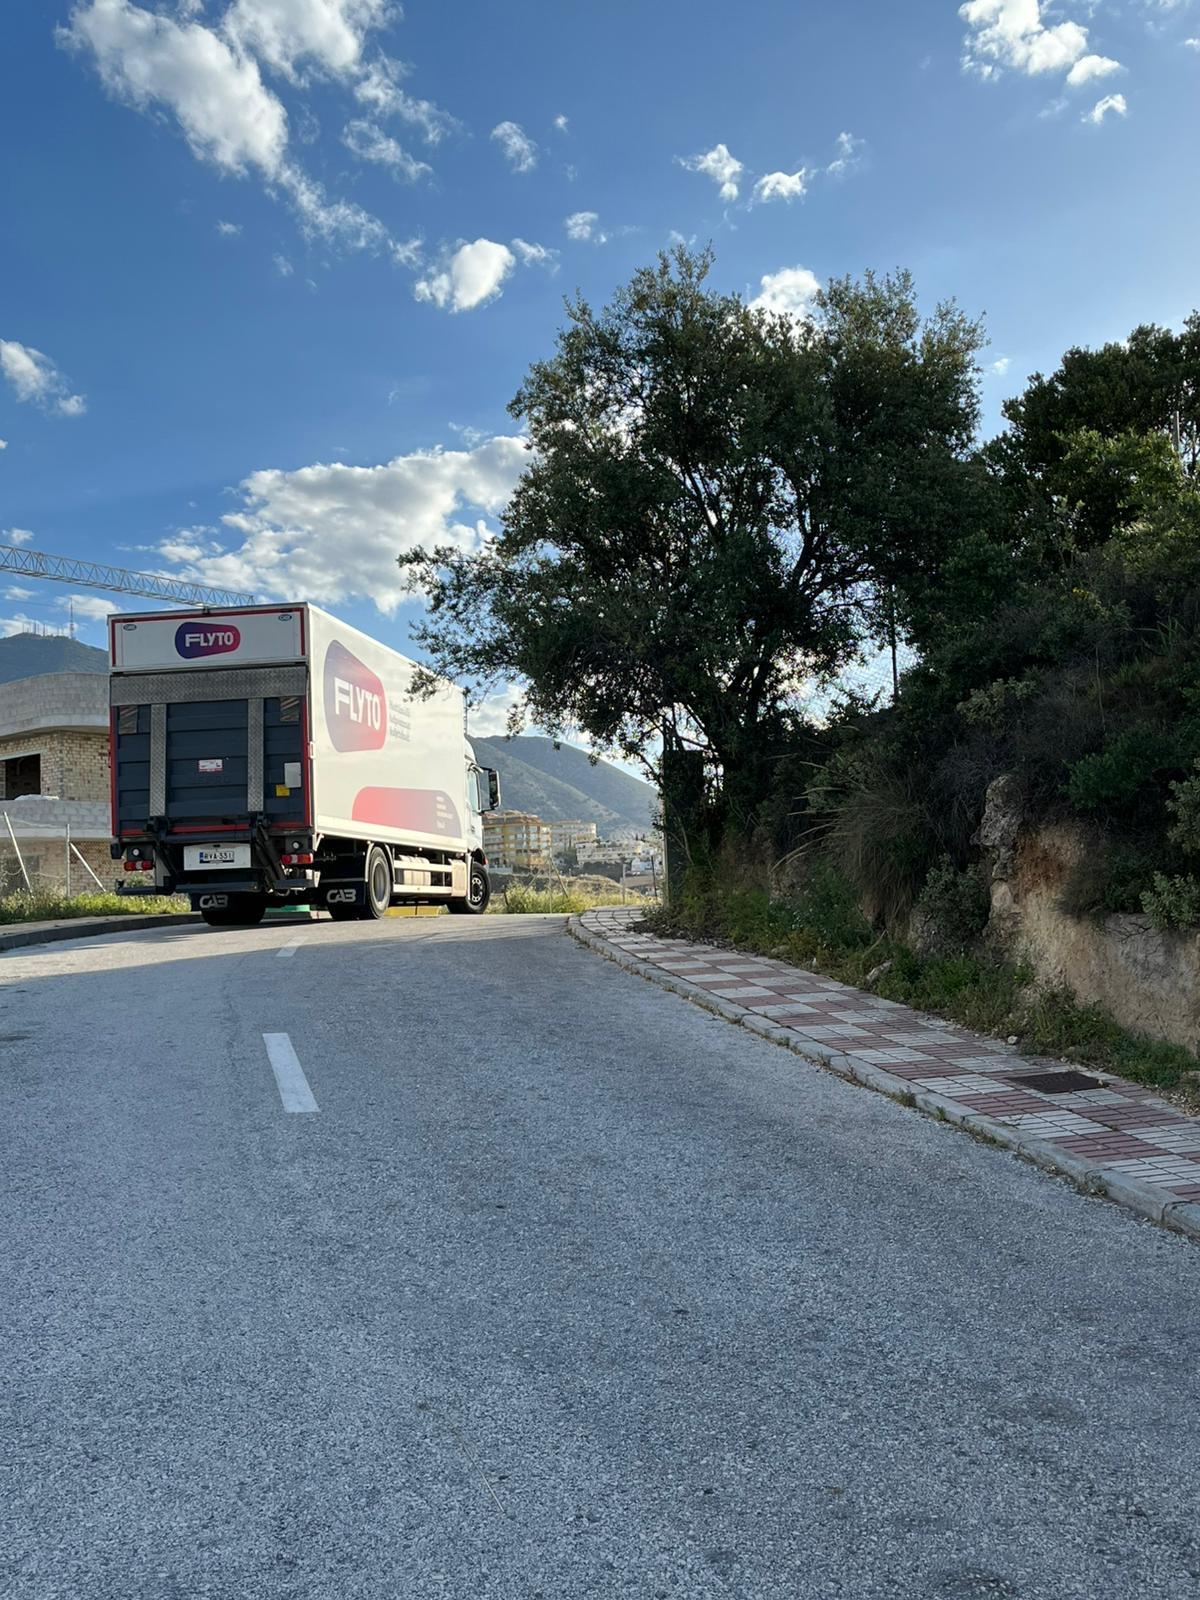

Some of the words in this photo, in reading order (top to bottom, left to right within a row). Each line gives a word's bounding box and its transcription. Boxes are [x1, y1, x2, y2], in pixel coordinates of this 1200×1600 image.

[185, 631, 234, 647] FLYTO
[334, 676, 381, 730] FLYTO
[199, 894, 229, 909] CAB
[326, 888, 357, 903] CAB
